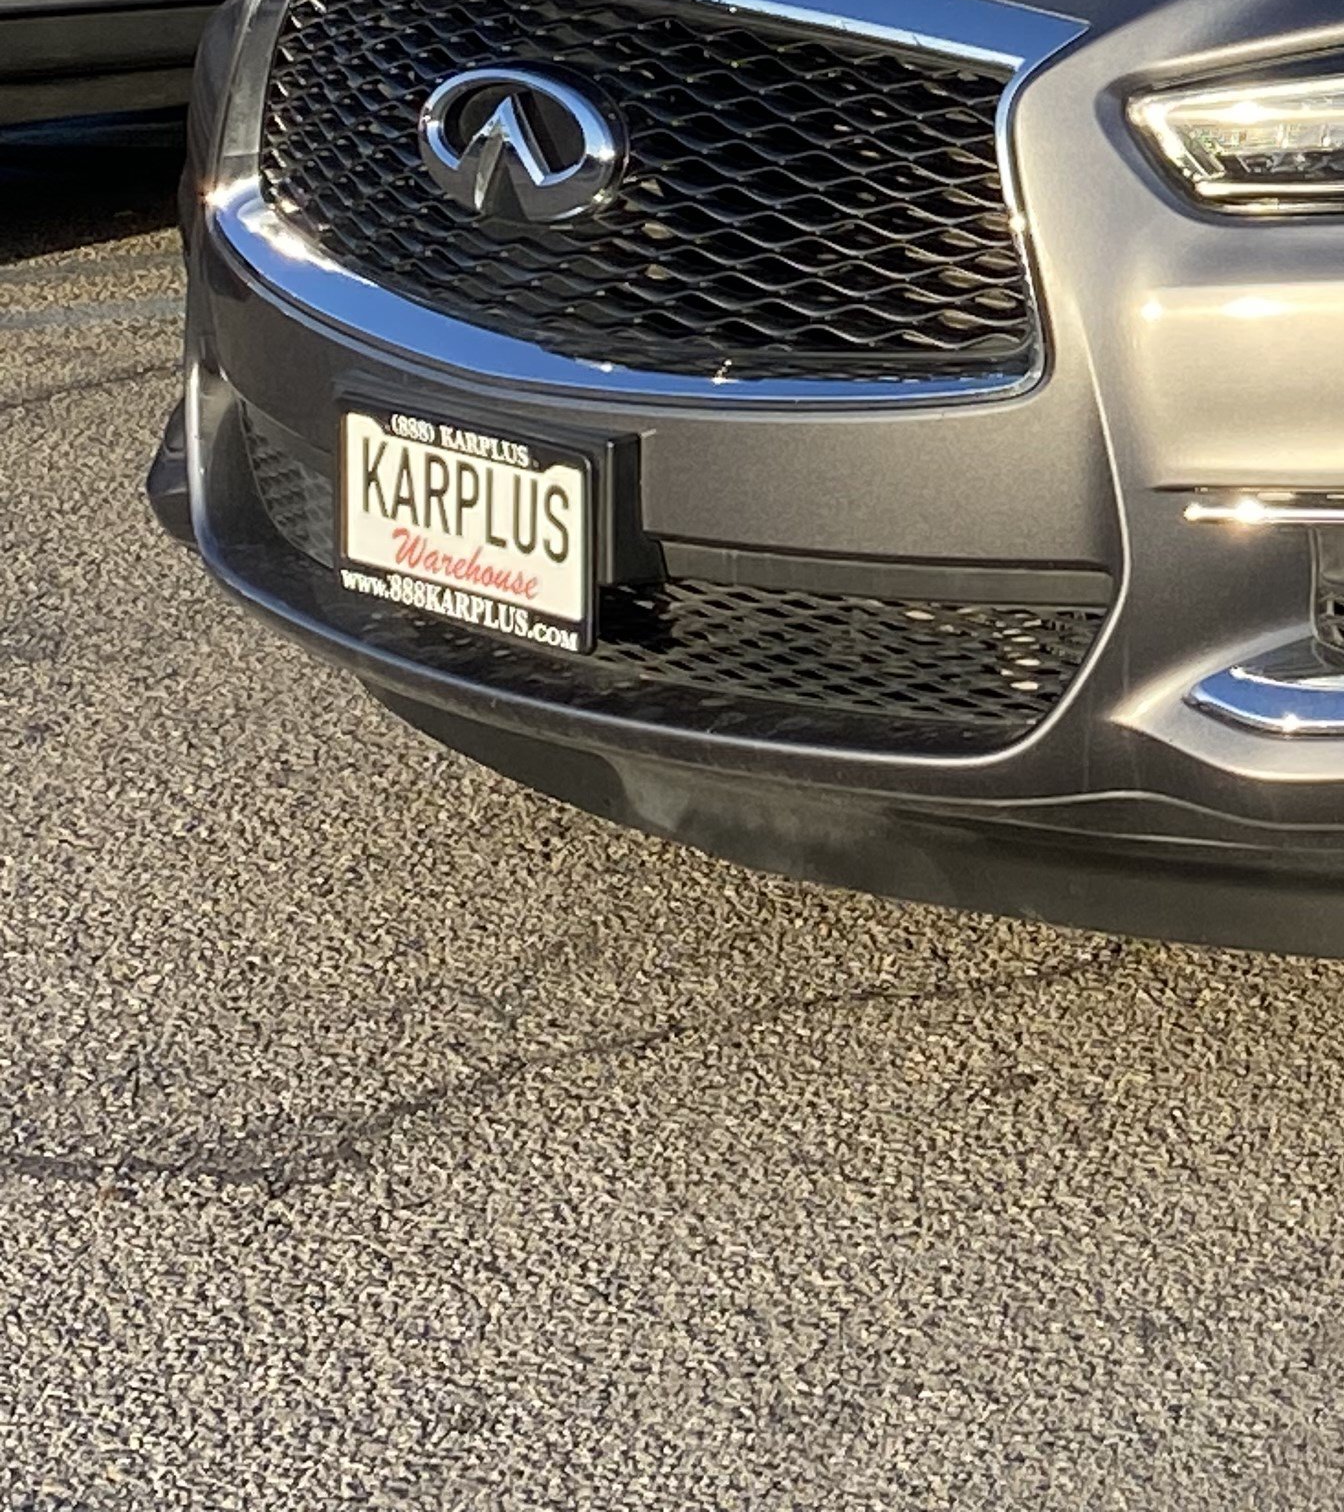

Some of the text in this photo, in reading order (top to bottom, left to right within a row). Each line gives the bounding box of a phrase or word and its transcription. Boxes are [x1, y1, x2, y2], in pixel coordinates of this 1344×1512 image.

[391, 414, 530, 468] (888) KARPLUS
[361, 435, 570, 565] KARPLUS
[391, 526, 540, 600] Warehouse
